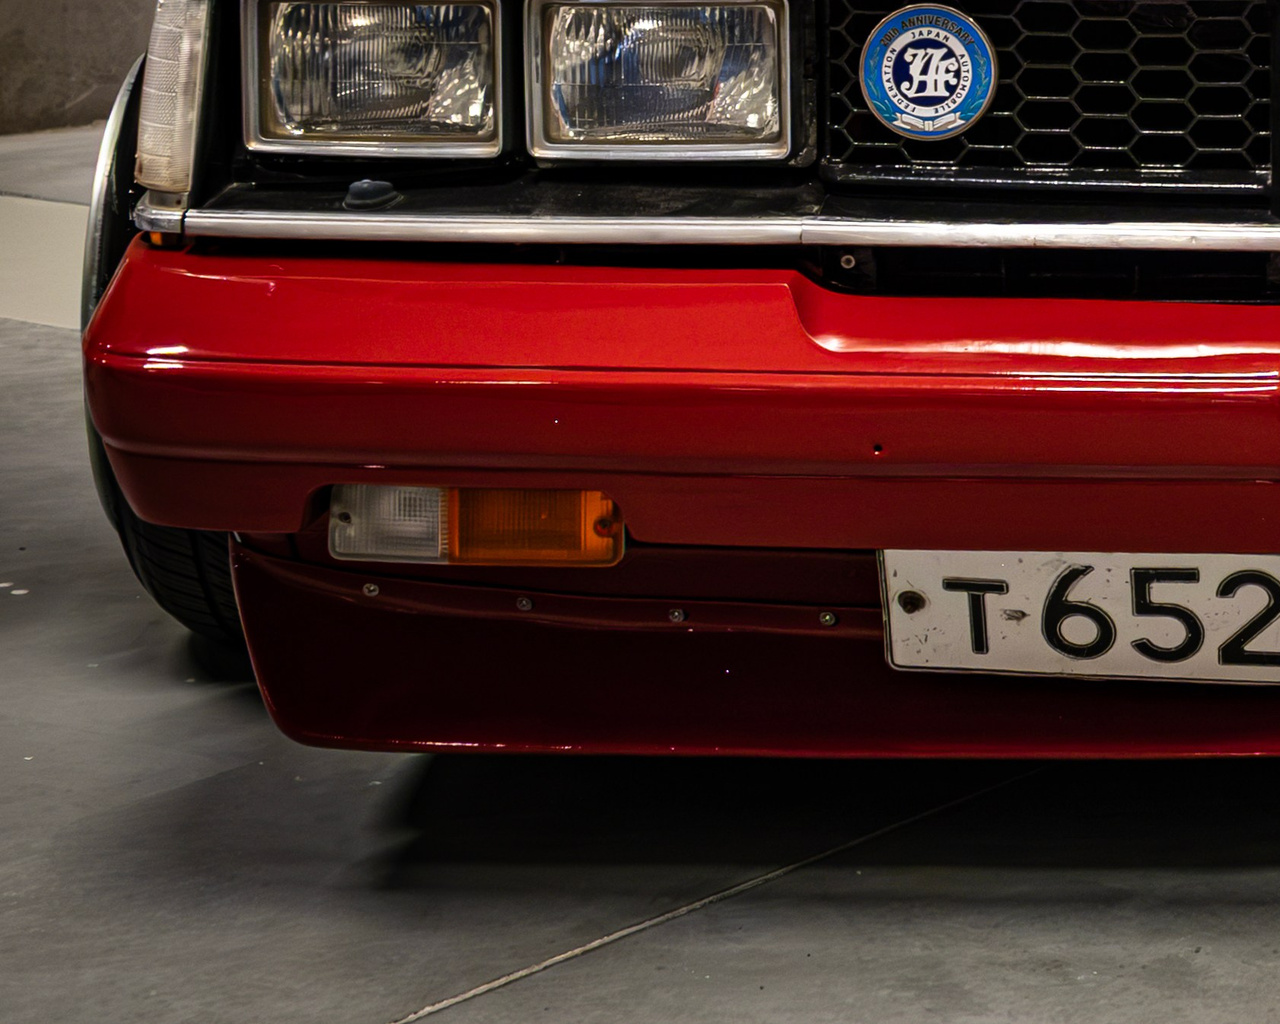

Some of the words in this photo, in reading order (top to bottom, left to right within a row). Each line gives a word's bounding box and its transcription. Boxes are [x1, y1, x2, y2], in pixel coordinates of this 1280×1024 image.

[901, 13, 976, 47] ANNIVERSARY
[911, 29, 951, 43] JAPAN
[884, 48, 917, 114] FEDERATION
[933, 53, 970, 114] AUTOMOBILE
